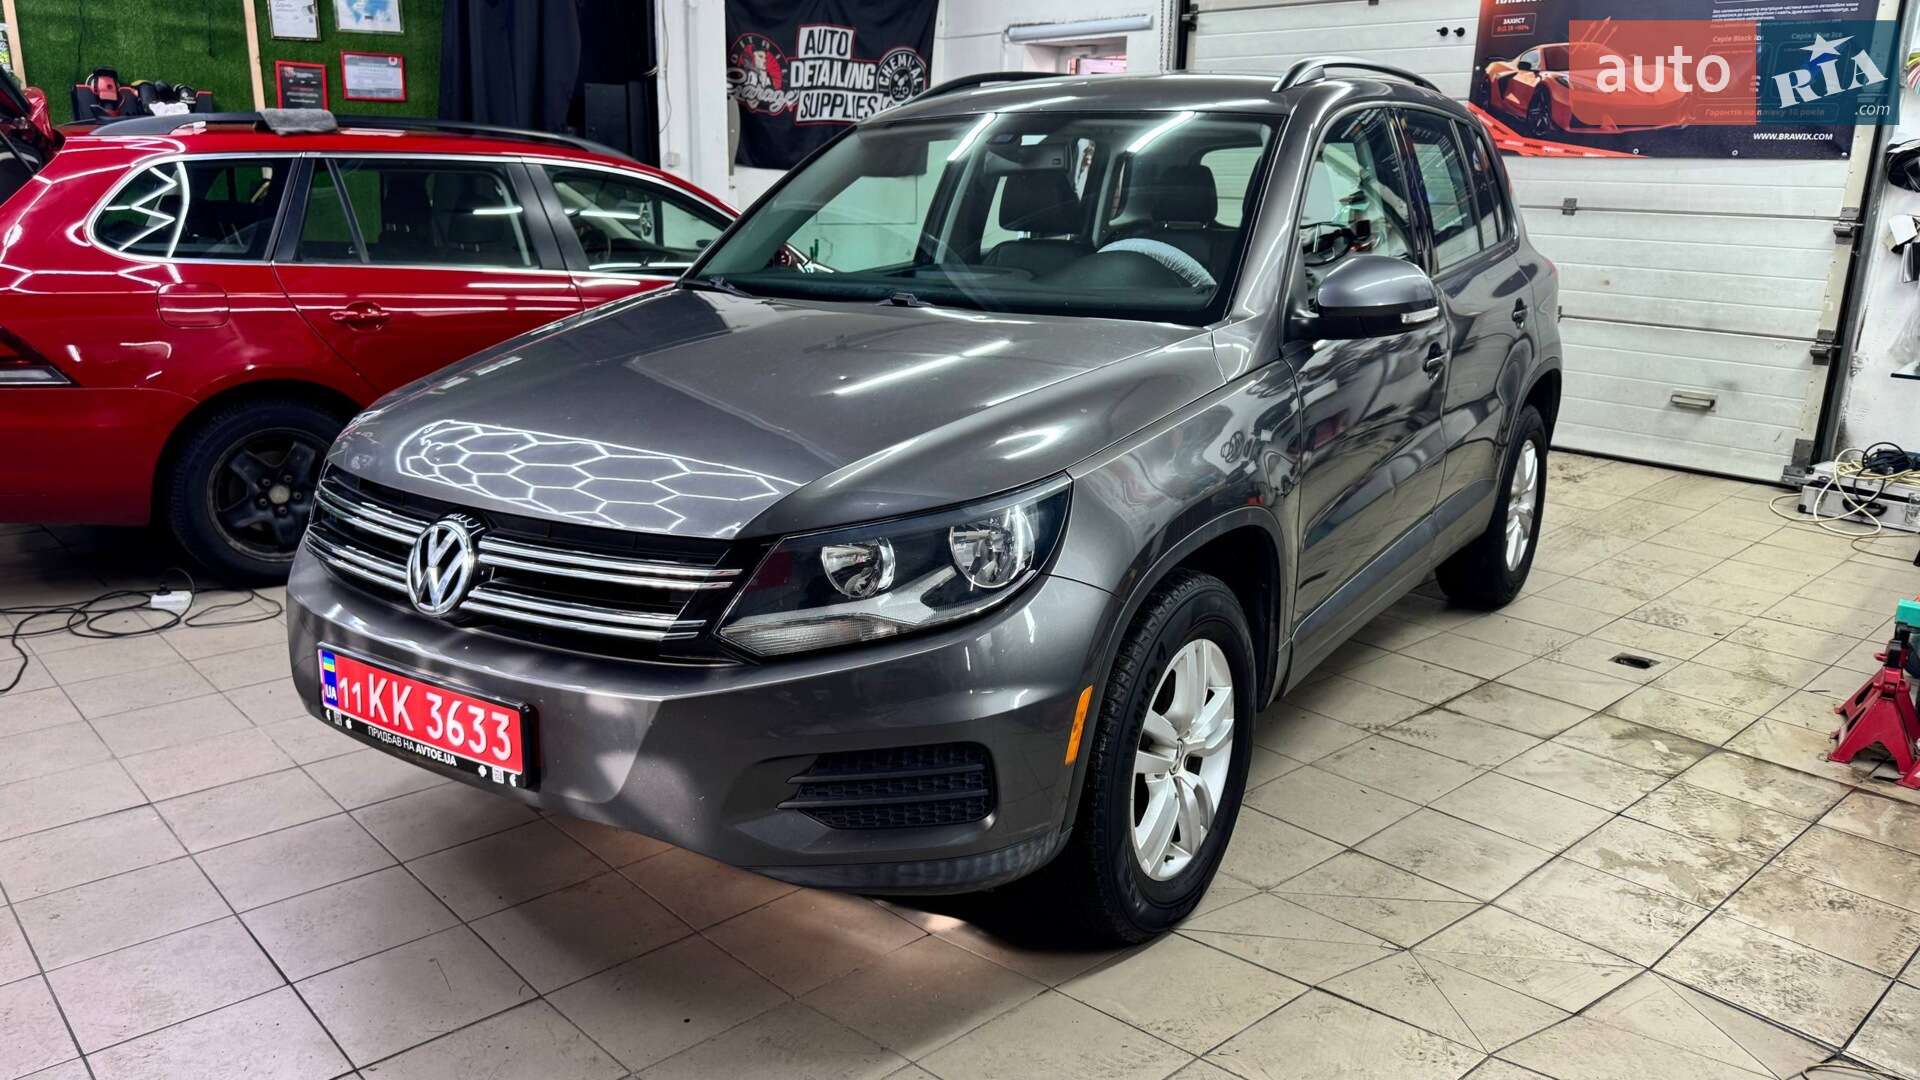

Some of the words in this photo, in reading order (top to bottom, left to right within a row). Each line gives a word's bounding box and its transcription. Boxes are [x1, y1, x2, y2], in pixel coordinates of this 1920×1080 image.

[804, 29, 849, 57] AUTO
[790, 61, 876, 90] DETAILING
[800, 91, 878, 119] SUPPLIES
[1753, 132, 1833, 141] WWW.BRAWIX.COM
[325, 684, 338, 700] UA
[367, 725, 402, 748] ПРИДБАВ
[403, 740, 415, 751] НА
[425, 691, 512, 761] 3633
